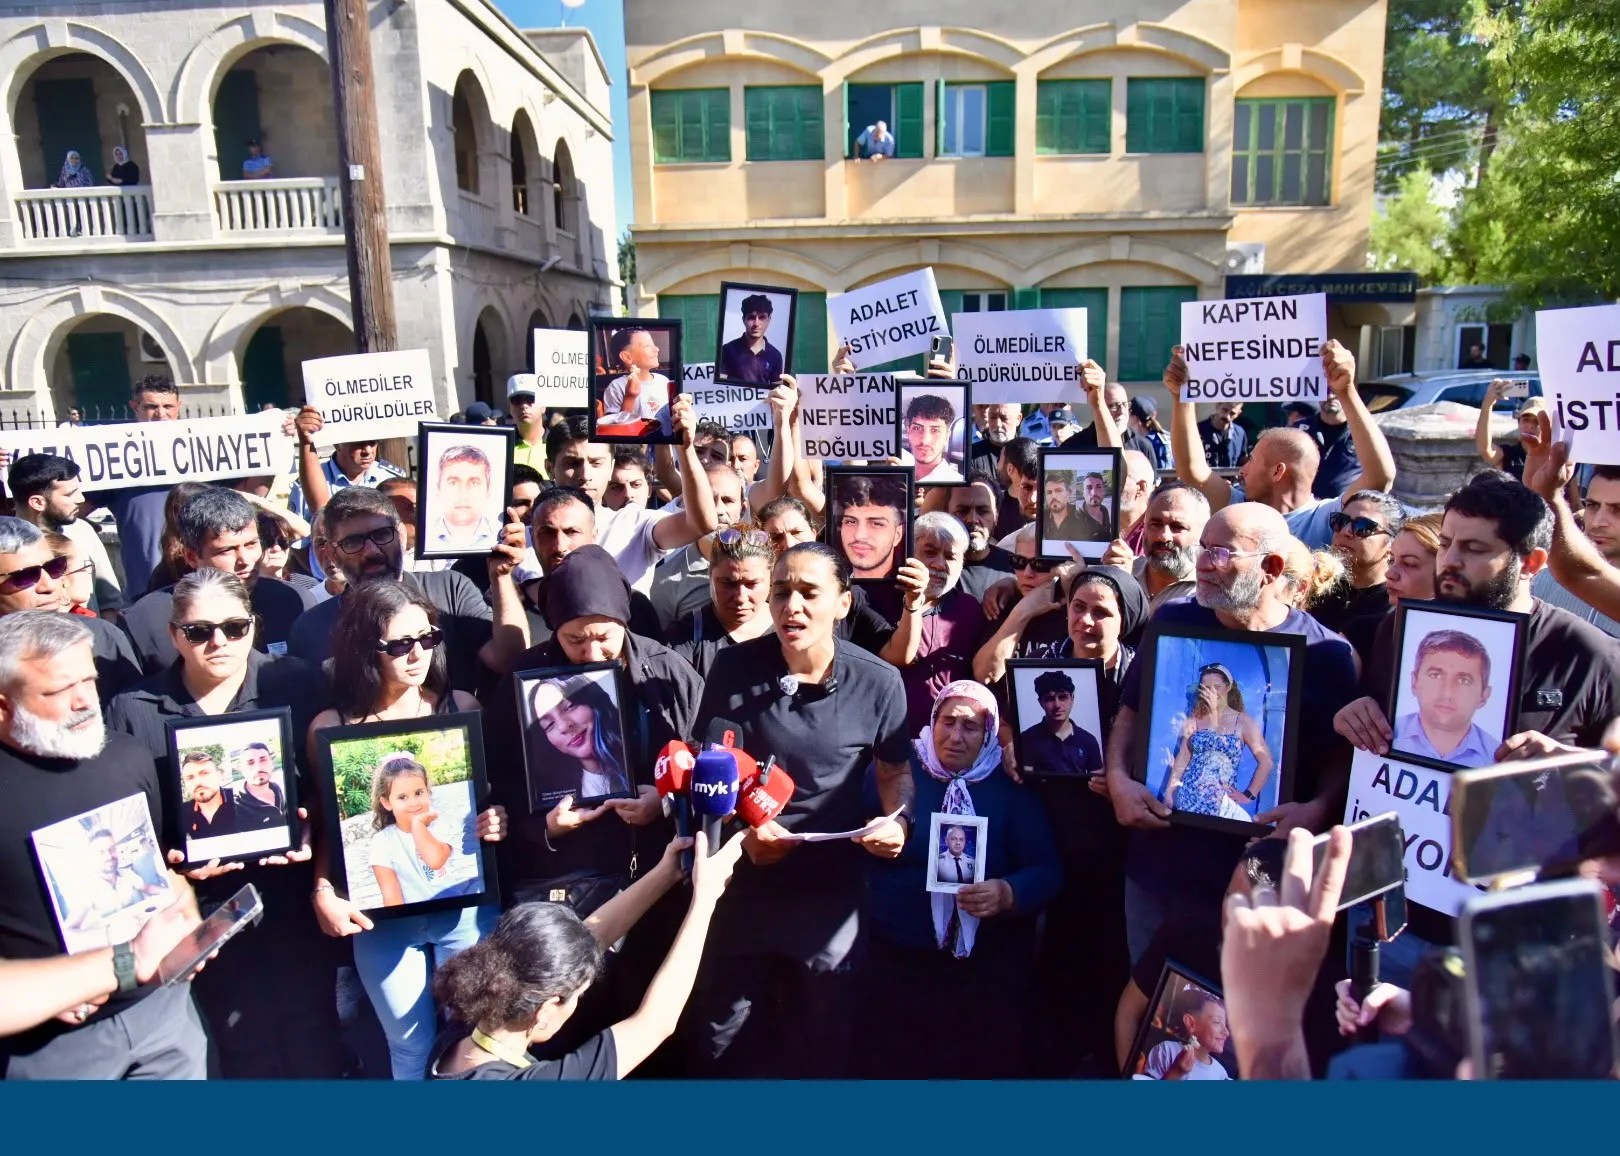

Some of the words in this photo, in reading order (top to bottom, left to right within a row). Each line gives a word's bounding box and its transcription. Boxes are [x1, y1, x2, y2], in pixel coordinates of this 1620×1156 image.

[850, 289, 919, 325] ADALET
[1202, 299, 1297, 325] KAPTAN
[843, 315, 940, 356] İSTİYORUZ
[974, 333, 1066, 354] ÖLMEDİLER
[1185, 334, 1320, 362] NEFESİNDE
[325, 373, 413, 396] ÖLMEDİLER
[688, 386, 765, 406] FESİNDE
[815, 375, 895, 394] KAPTAN
[1186, 373, 1320, 399] BOĞULSUN
[322, 400, 434, 424] LDÜRÜLDÜLER
[699, 412, 767, 429] ĞULSUN
[85, 430, 167, 482] DEĞİL
[172, 427, 272, 475] CİNAYET
[694, 780, 728, 797] myk
